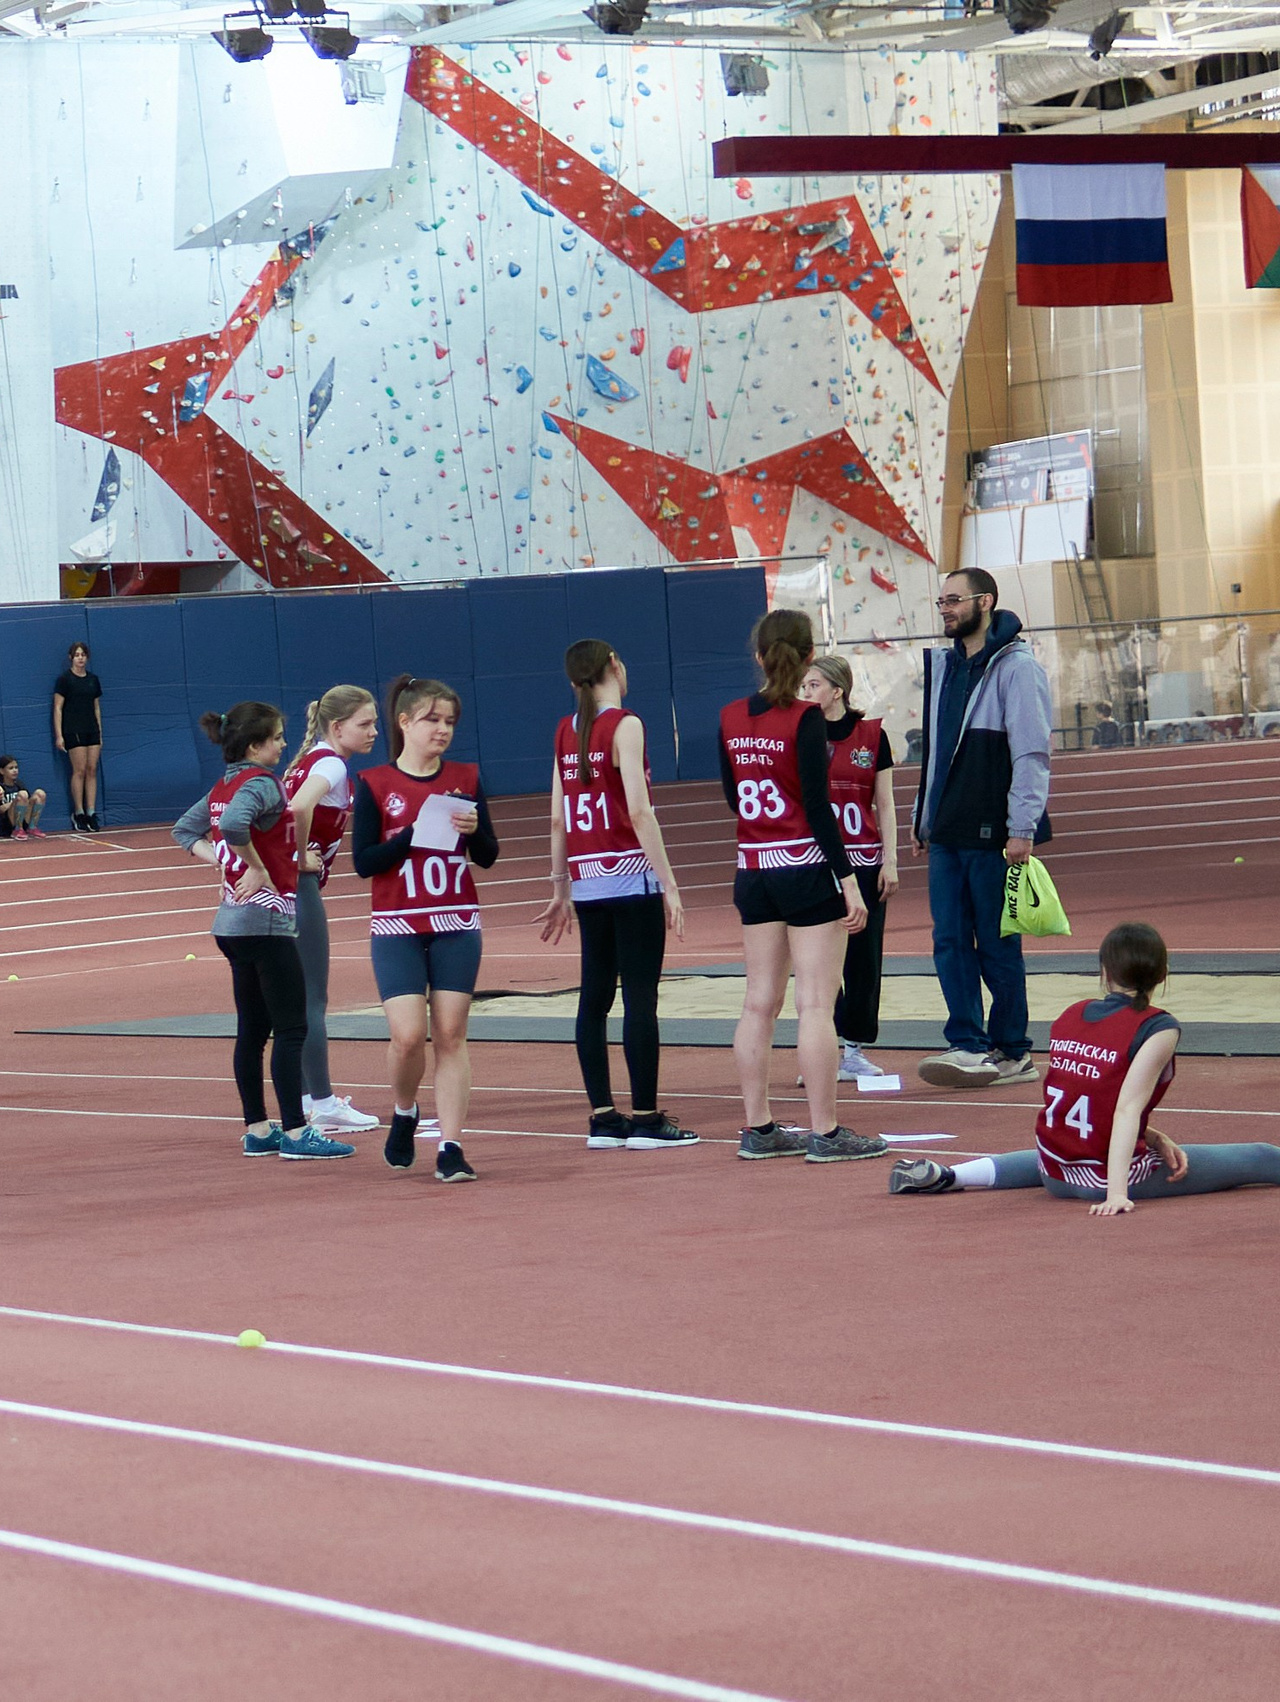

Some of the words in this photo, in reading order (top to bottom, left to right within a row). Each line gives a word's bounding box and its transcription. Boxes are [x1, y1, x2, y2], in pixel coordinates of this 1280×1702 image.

[563, 792, 610, 833] 151
[737, 779, 786, 820] 83
[399, 856, 467, 899] 107
[1046, 1085, 1094, 1139] 74
